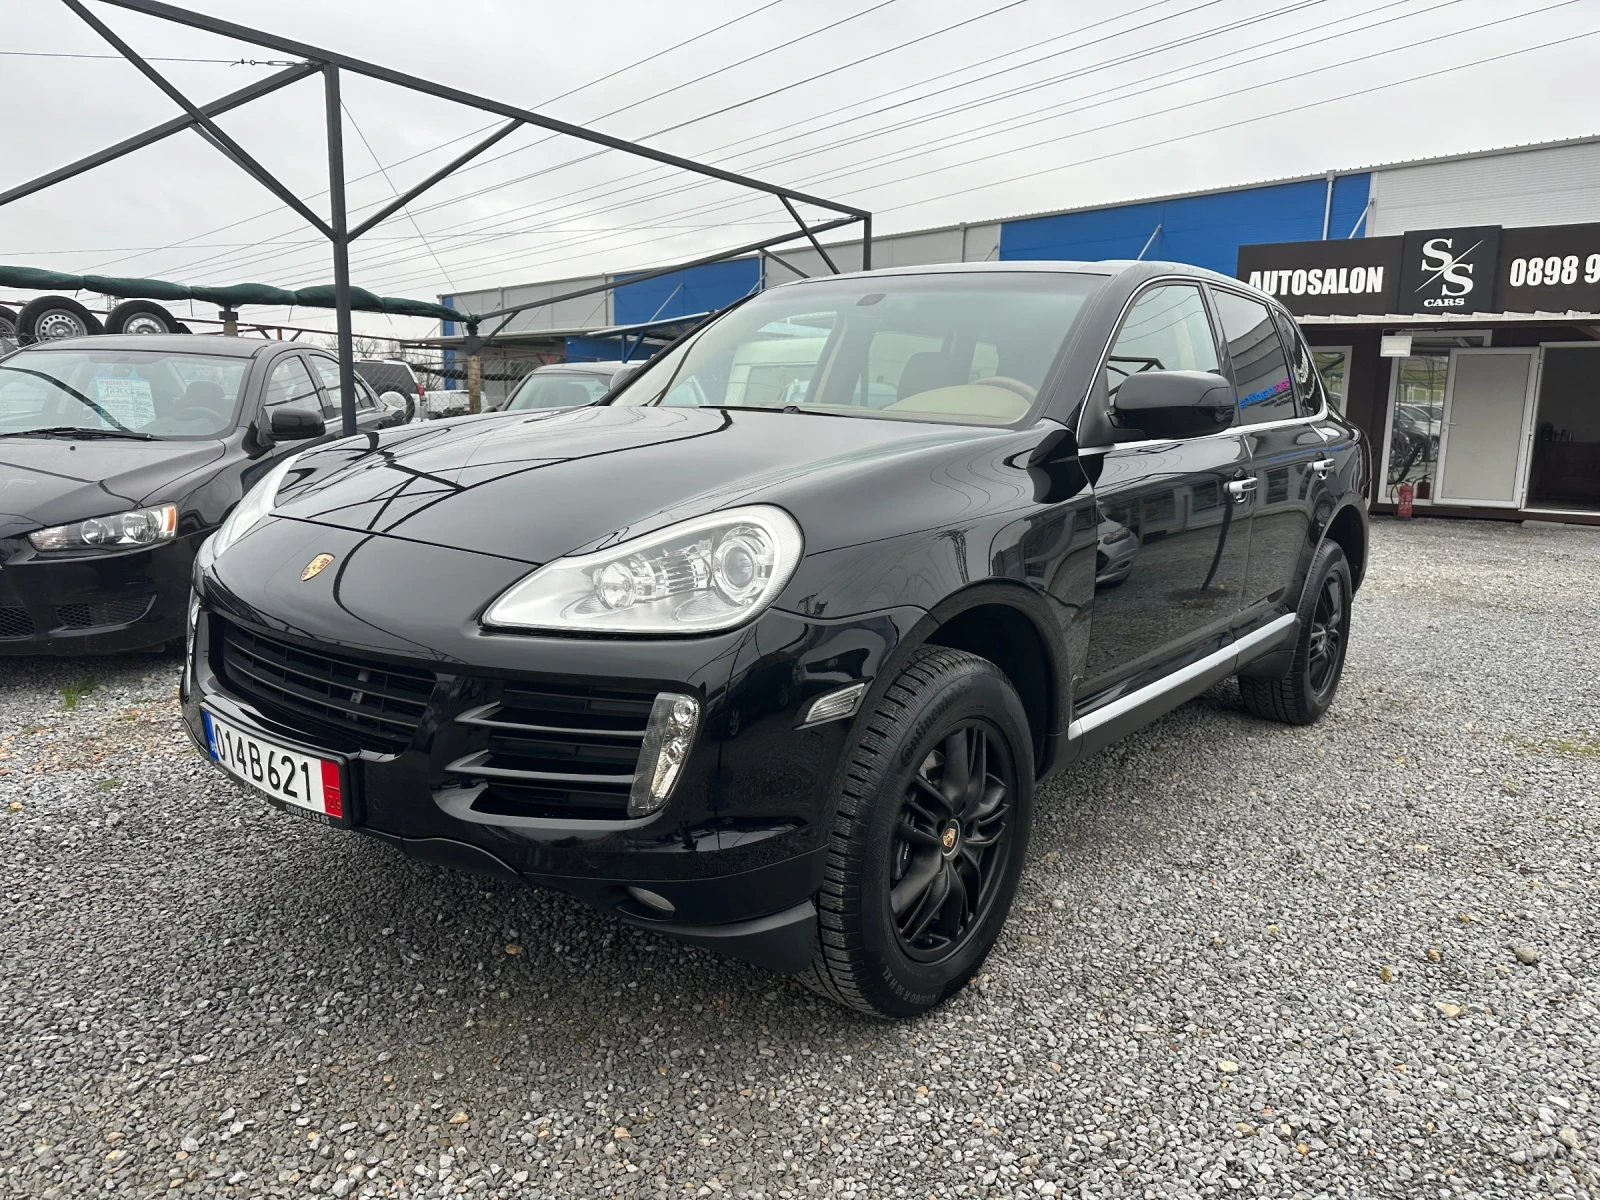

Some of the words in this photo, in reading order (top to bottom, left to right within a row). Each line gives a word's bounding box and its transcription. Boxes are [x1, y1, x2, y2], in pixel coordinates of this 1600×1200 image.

[1249, 266, 1384, 296] AUTOSALON
[1509, 255, 1579, 287] 0898
[1584, 253, 1600, 283] 9
[1423, 297, 1465, 307] CARS
[900, 684, 965, 767] Continental
